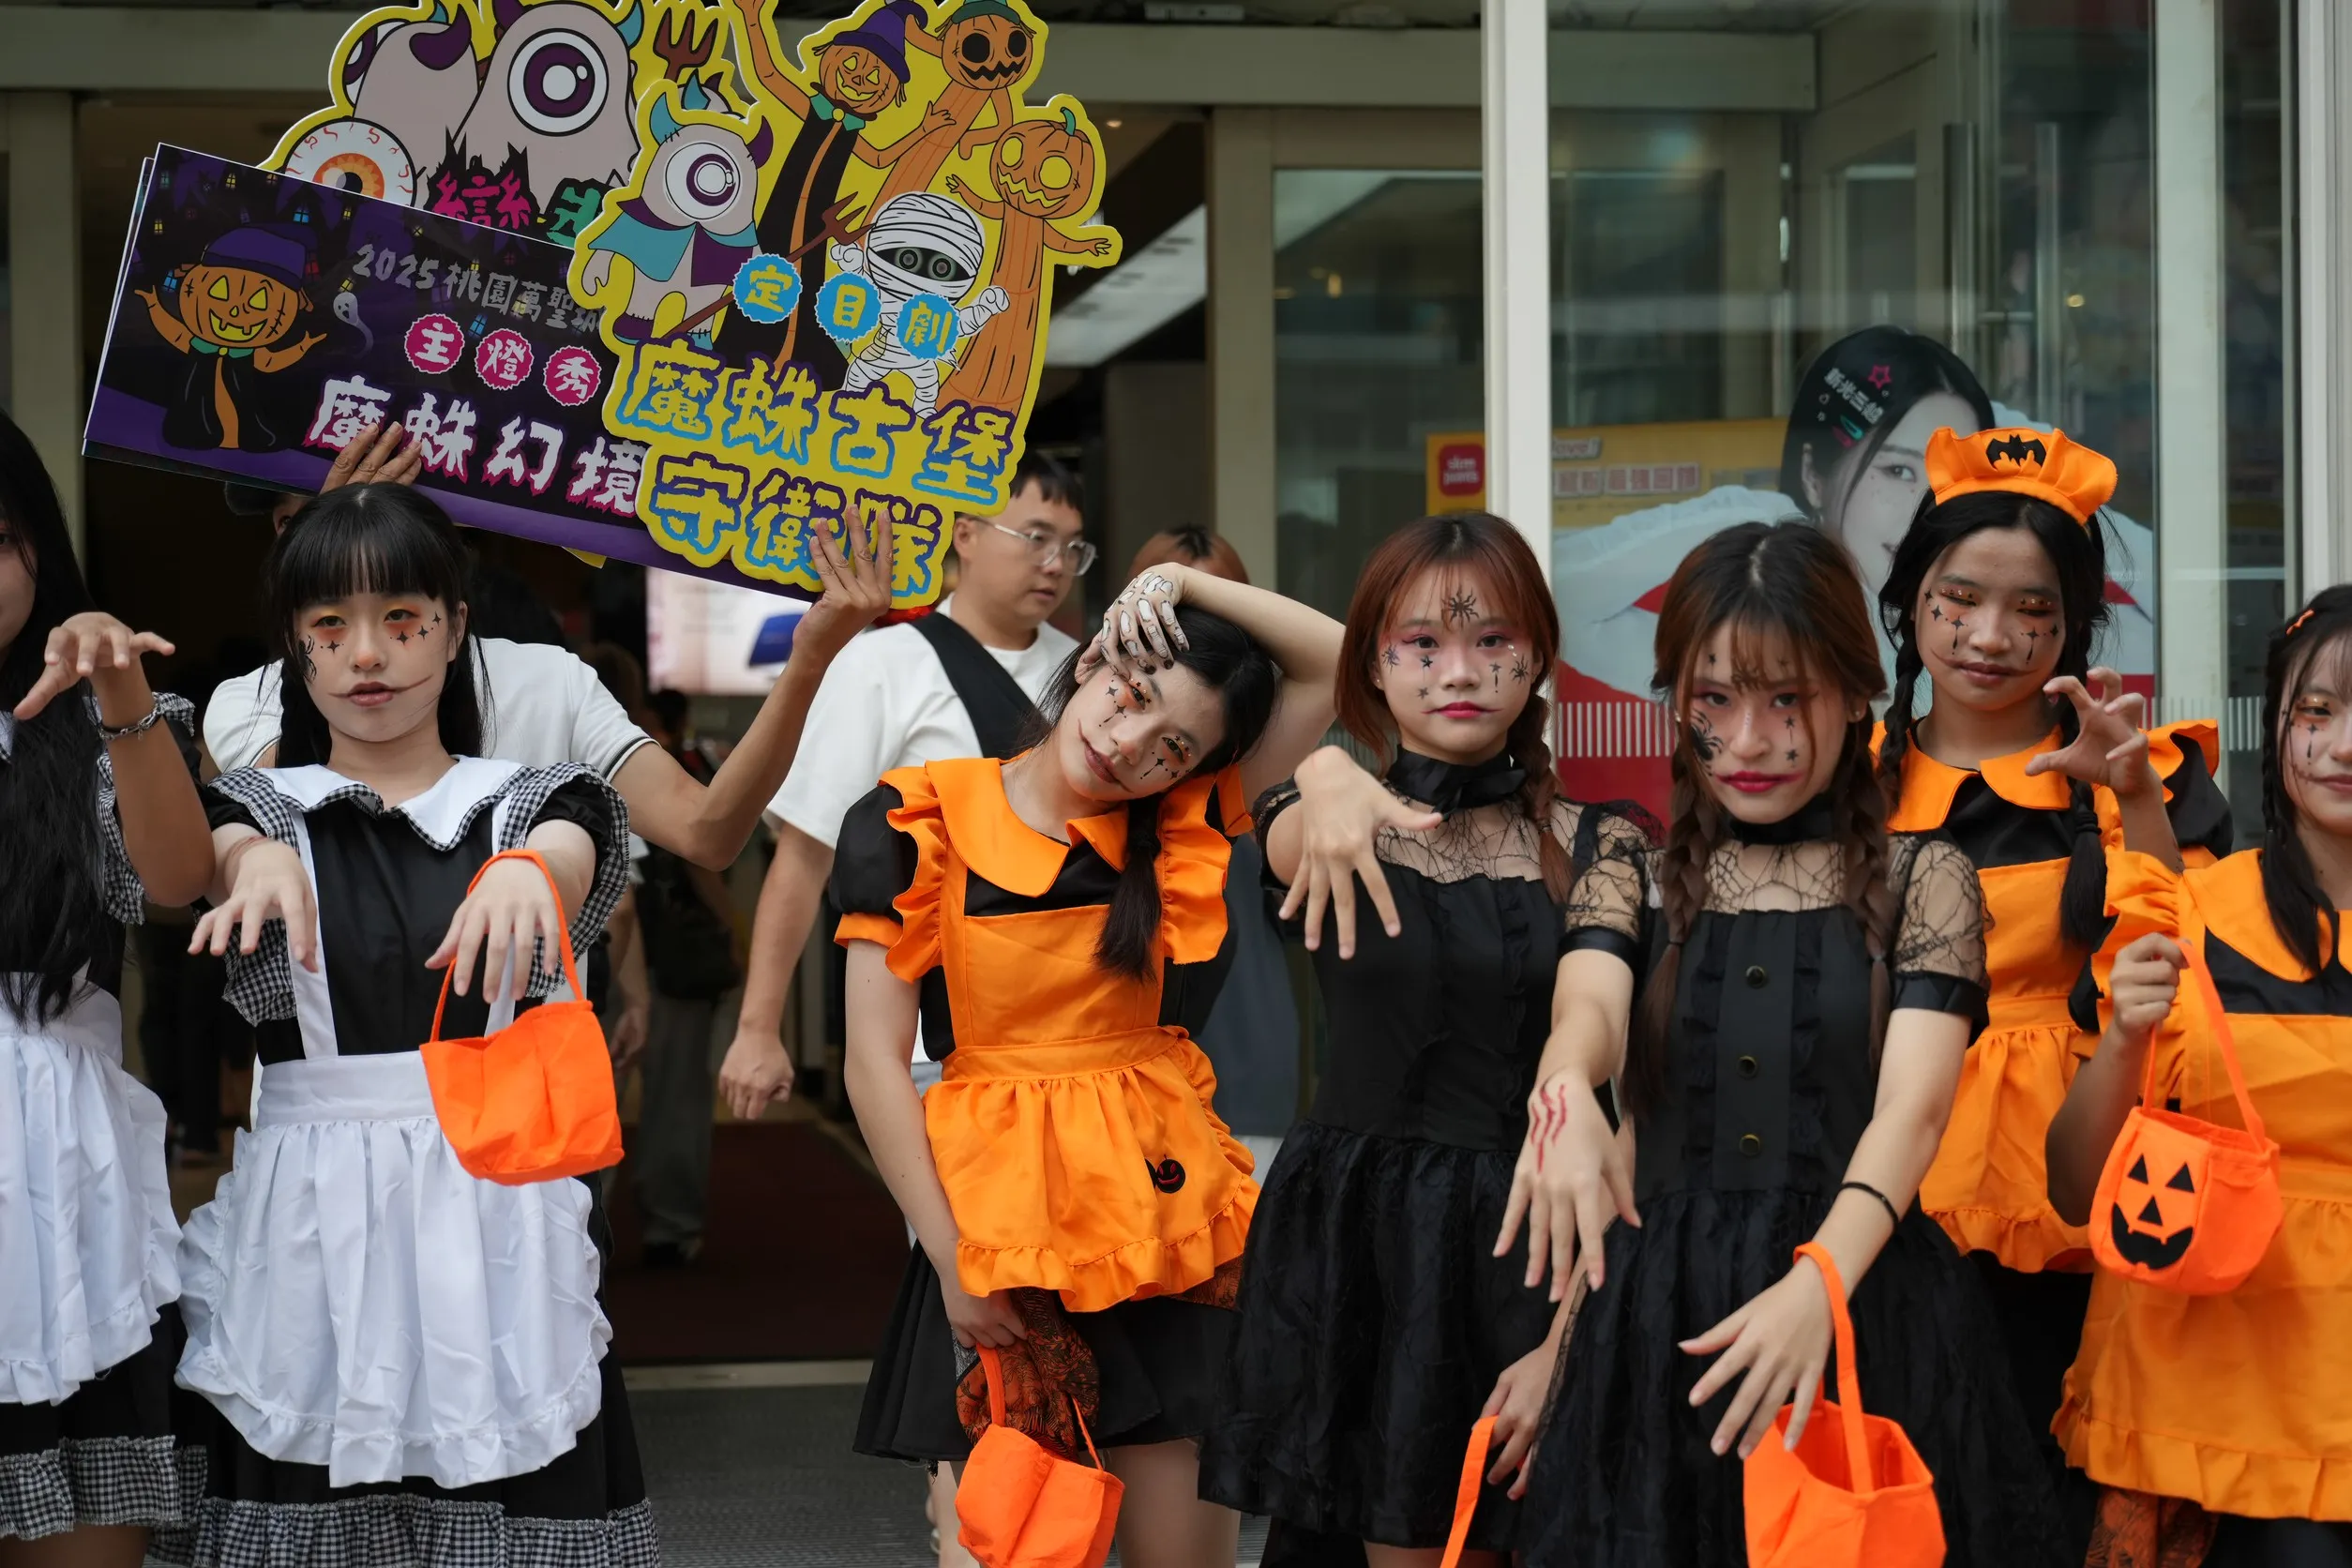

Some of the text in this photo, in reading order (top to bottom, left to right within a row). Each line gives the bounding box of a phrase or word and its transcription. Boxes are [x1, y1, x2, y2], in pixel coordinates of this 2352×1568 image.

[415, 323, 595, 400] 主燈秀
[746, 265, 947, 354] 定目劇
[304, 374, 644, 516] 魔蛛幻境
[620, 335, 1014, 505] 魔蛛古堡
